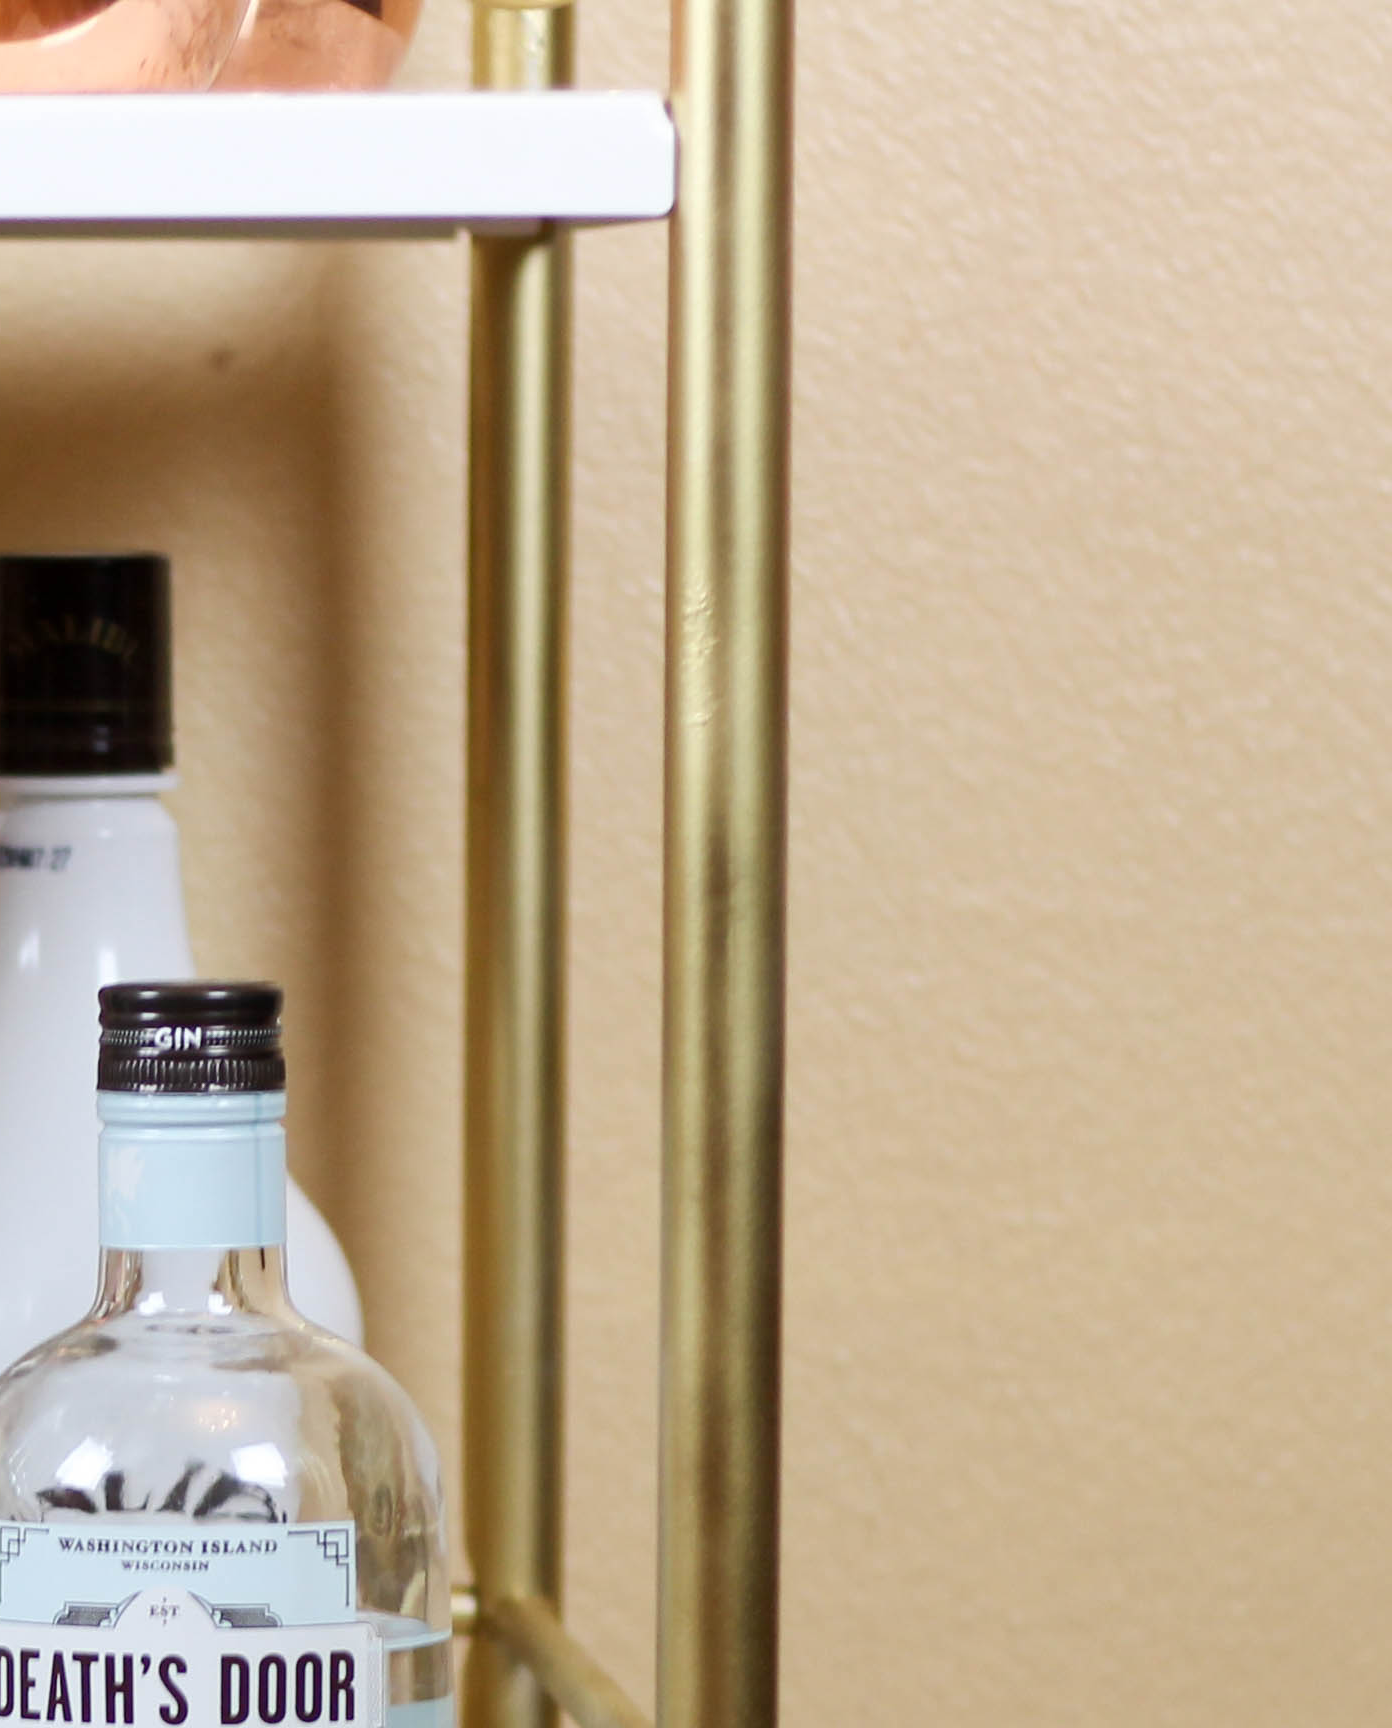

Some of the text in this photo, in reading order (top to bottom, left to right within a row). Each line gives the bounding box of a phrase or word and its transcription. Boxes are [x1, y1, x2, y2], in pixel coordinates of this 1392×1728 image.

[154, 1026, 203, 1051] GIN
[58, 1537, 278, 1556] WASHINGTON ISLAND
[121, 1559, 210, 1573] WISCONSIN
[148, 1603, 181, 1619] EST
[219, 1650, 356, 1726] DOOR
